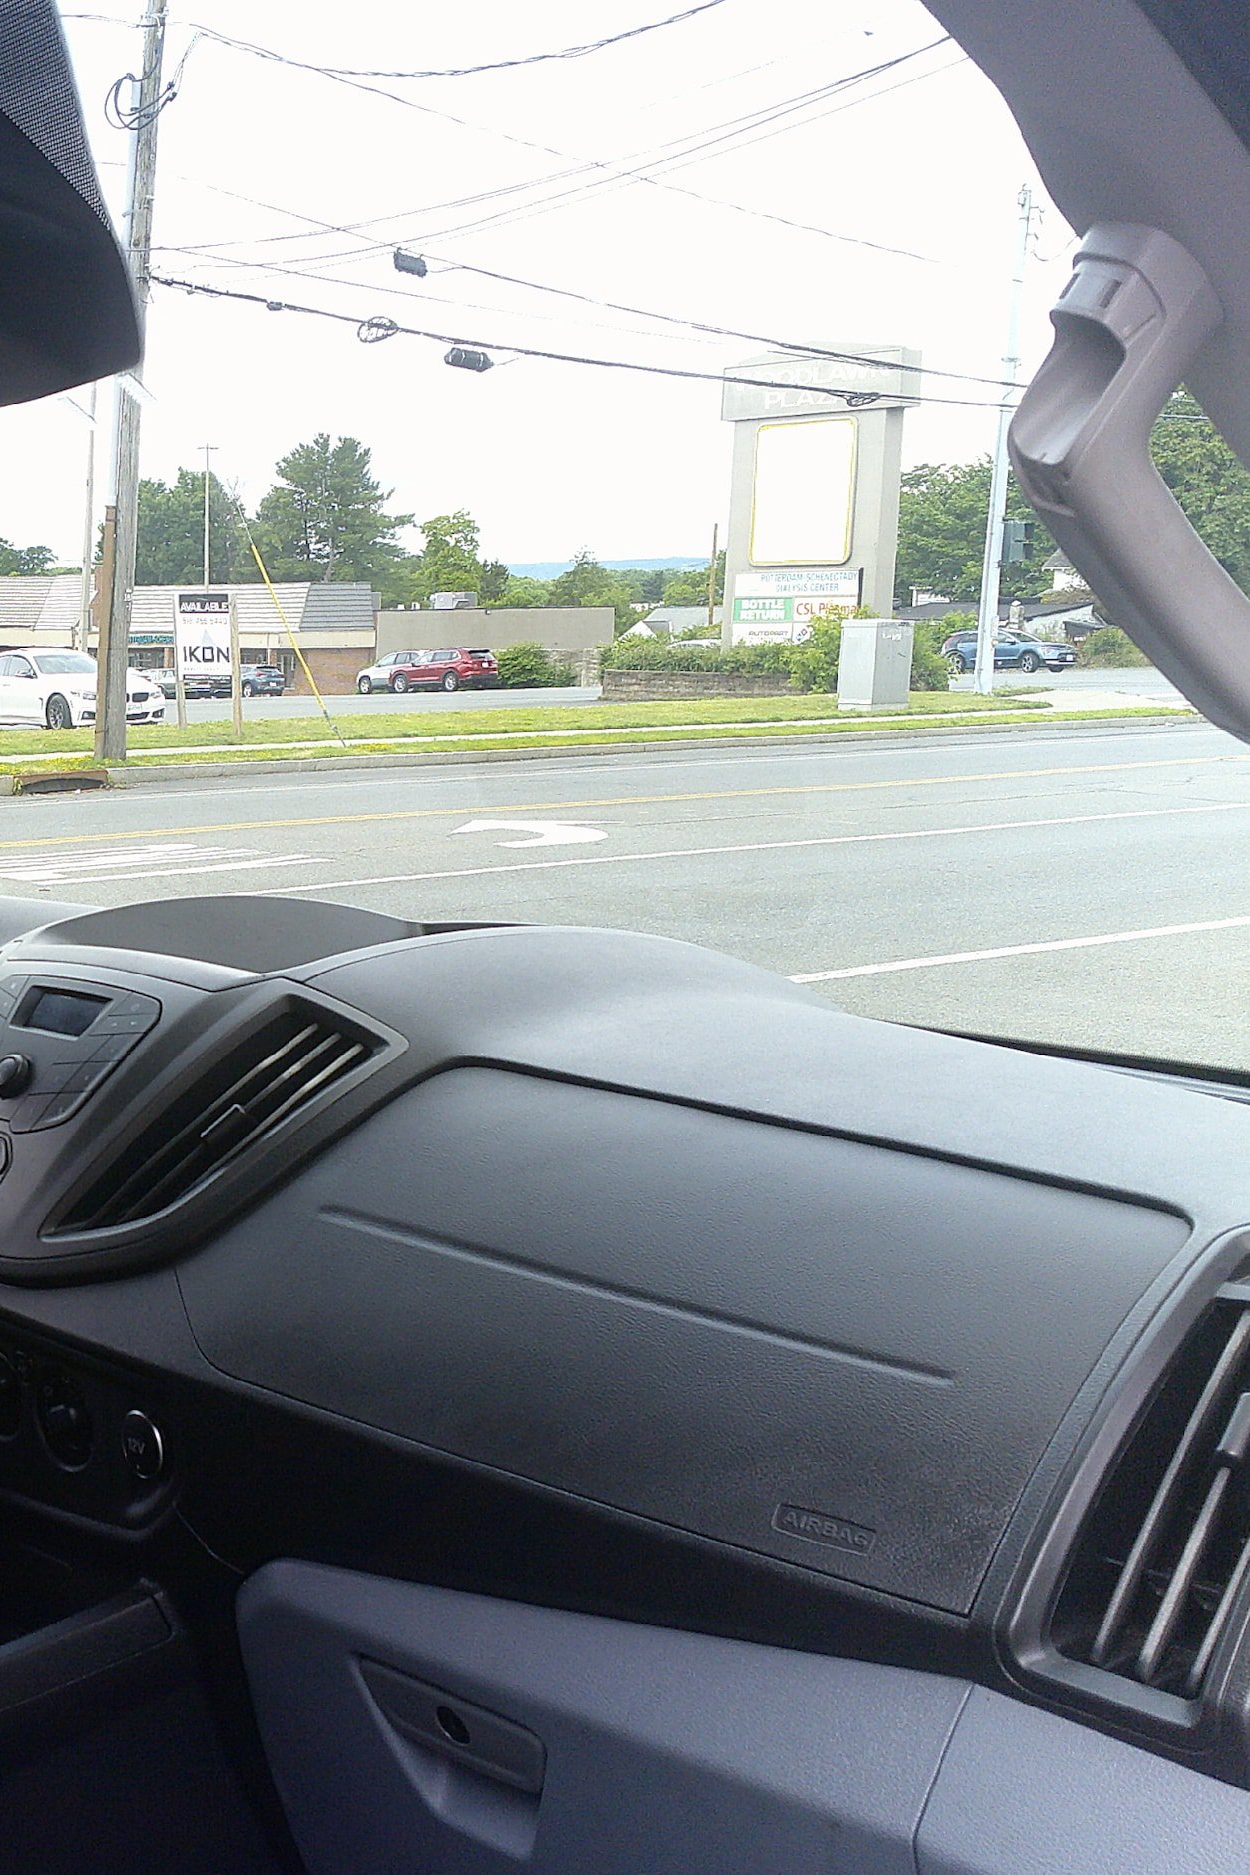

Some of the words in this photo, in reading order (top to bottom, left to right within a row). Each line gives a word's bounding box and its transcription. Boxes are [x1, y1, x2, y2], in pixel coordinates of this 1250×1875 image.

[810, 583, 839, 592] CENTER
[180, 601, 229, 612] AVAILABLE
[741, 599, 785, 610] BOTTLE
[796, 602, 816, 616] CSL
[739, 609, 785, 620] RETURN
[183, 646, 230, 663] IKON
[127, 1437, 145, 1455] 12V
[782, 1510, 869, 1546] AIRBAG
